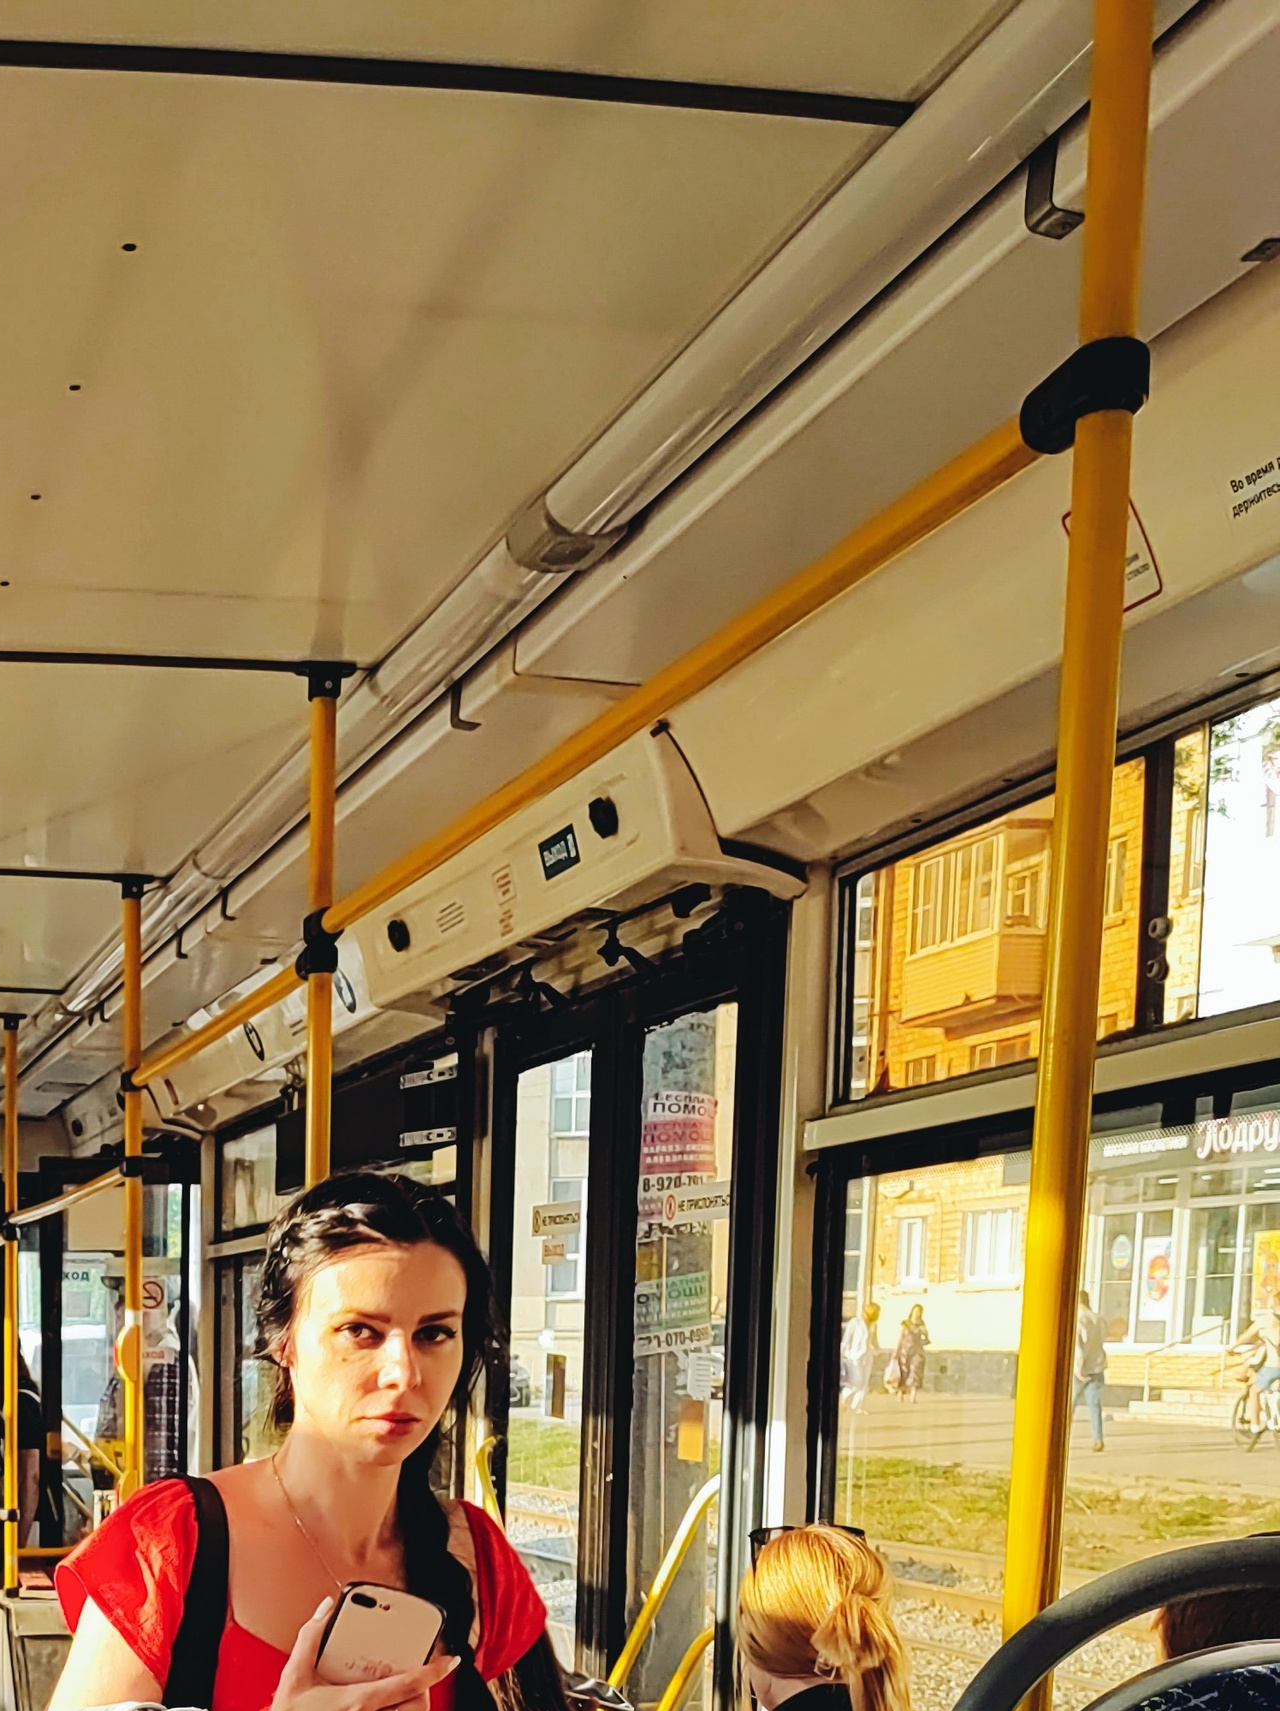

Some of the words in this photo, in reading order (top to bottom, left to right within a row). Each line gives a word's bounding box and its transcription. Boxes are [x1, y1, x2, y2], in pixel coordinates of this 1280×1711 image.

[1230, 479, 1245, 494] Во
[1245, 461, 1275, 486] время
[63, 1271, 90, 1282] ХОД
